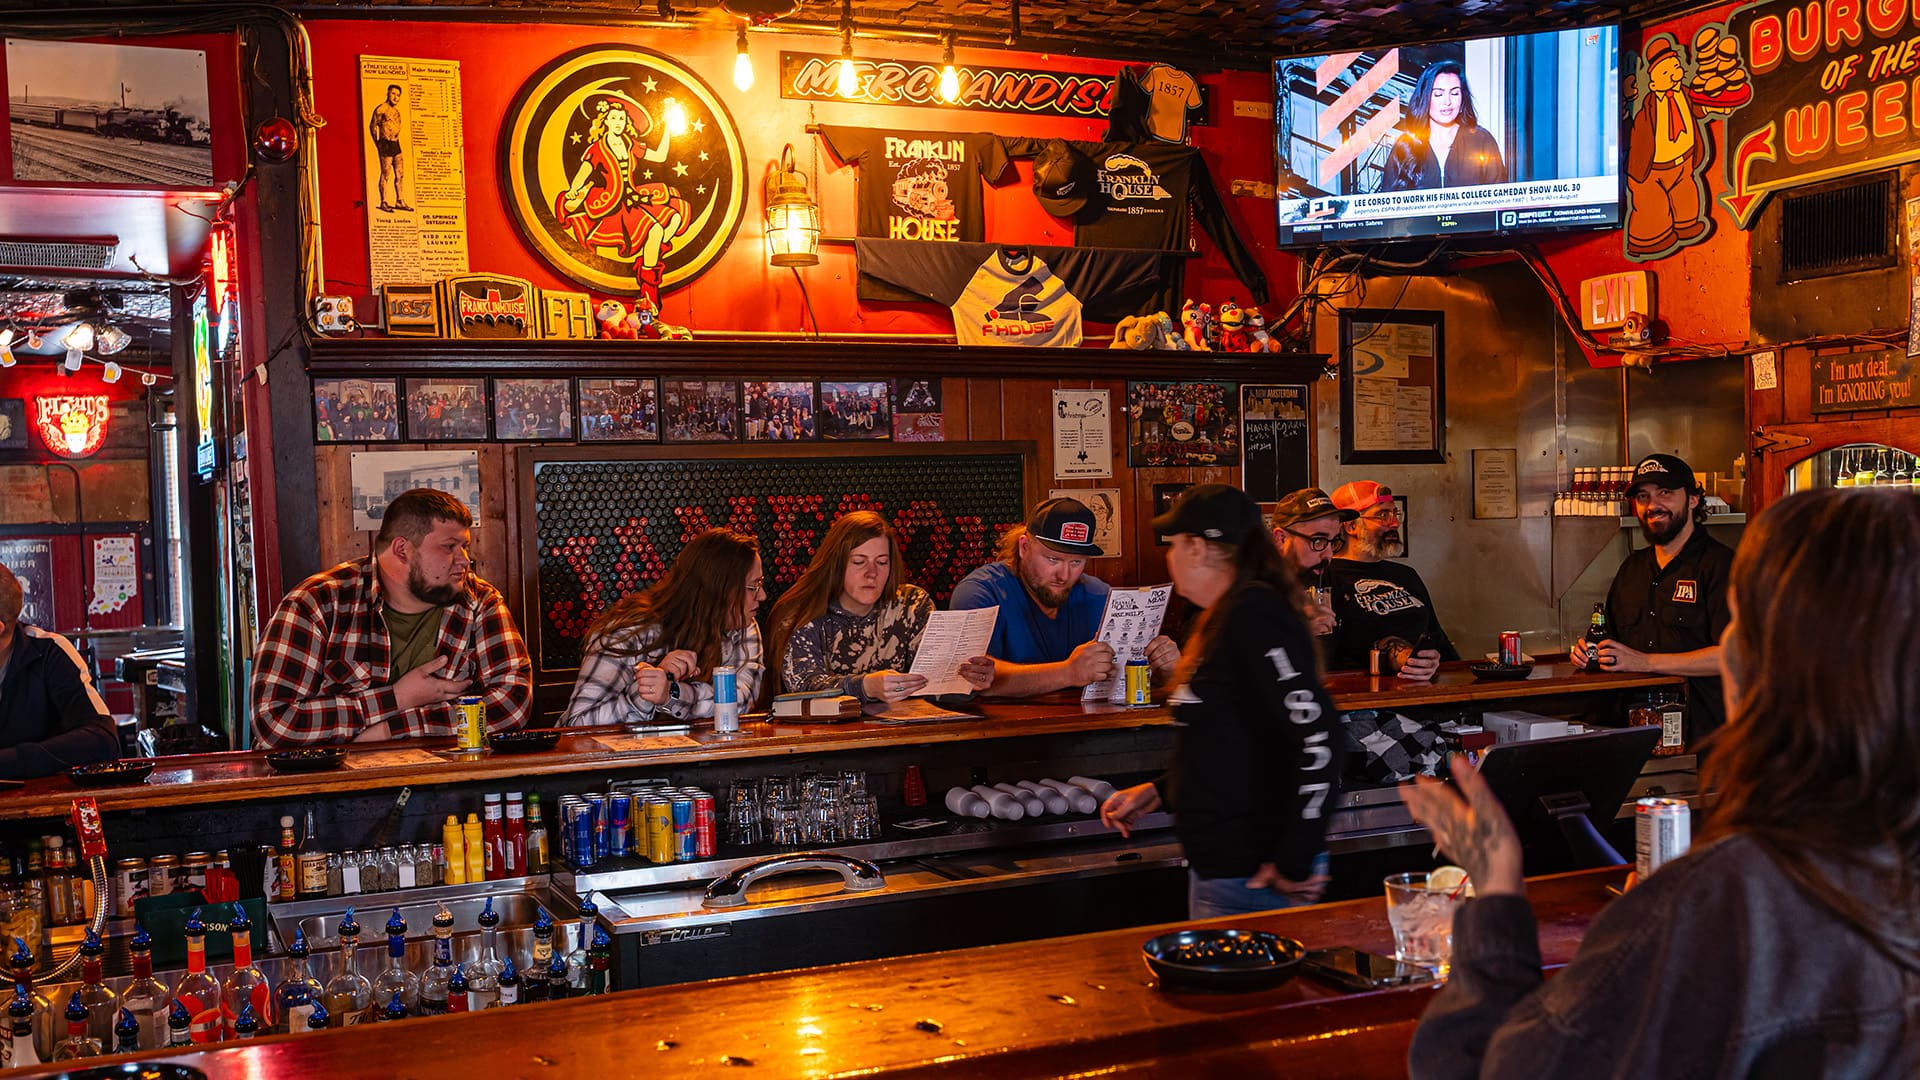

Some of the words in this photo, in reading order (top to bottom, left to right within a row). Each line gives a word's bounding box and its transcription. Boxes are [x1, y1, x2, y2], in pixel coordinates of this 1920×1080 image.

[1750, 0, 1920, 71] BURG
[1821, 55, 1861, 91] OF
[1867, 37, 1920, 79] THE
[1158, 80, 1185, 98] 1857
[884, 136, 965, 162] FRANKLIN
[947, 163, 961, 171] 1857
[1097, 169, 1160, 184] FRANKLIN
[1100, 182, 1152, 200] HOUSE
[1354, 199, 1366, 207] LEE
[1367, 197, 1390, 206] CORSO
[1392, 196, 1401, 204] TO
[1402, 194, 1425, 203] WORK
[1426, 193, 1438, 202] HIS
[1439, 191, 1460, 201] FINAL
[1461, 188, 1492, 200] COLLEGE
[1493, 186, 1527, 197] GAMEDAY
[1528, 185, 1551, 195] SHOW
[1552, 184, 1570, 193] AUG.
[1571, 183, 1581, 191] 30
[1127, 206, 1144, 214] 1857
[888, 215, 960, 241] HOUSE
[392, 299, 432, 316] 1857
[1591, 274, 1639, 325] EXIT
[996, 321, 1055, 336] HOUSE
[1830, 360, 1845, 380] I'm
[1848, 360, 1864, 379] not
[1819, 384, 1834, 405] I'm
[1837, 380, 1886, 404] IGNORING
[1888, 375, 1911, 406] you!
[1676, 584, 1694, 599] IPA
[1264, 647, 1332, 820] 1857
